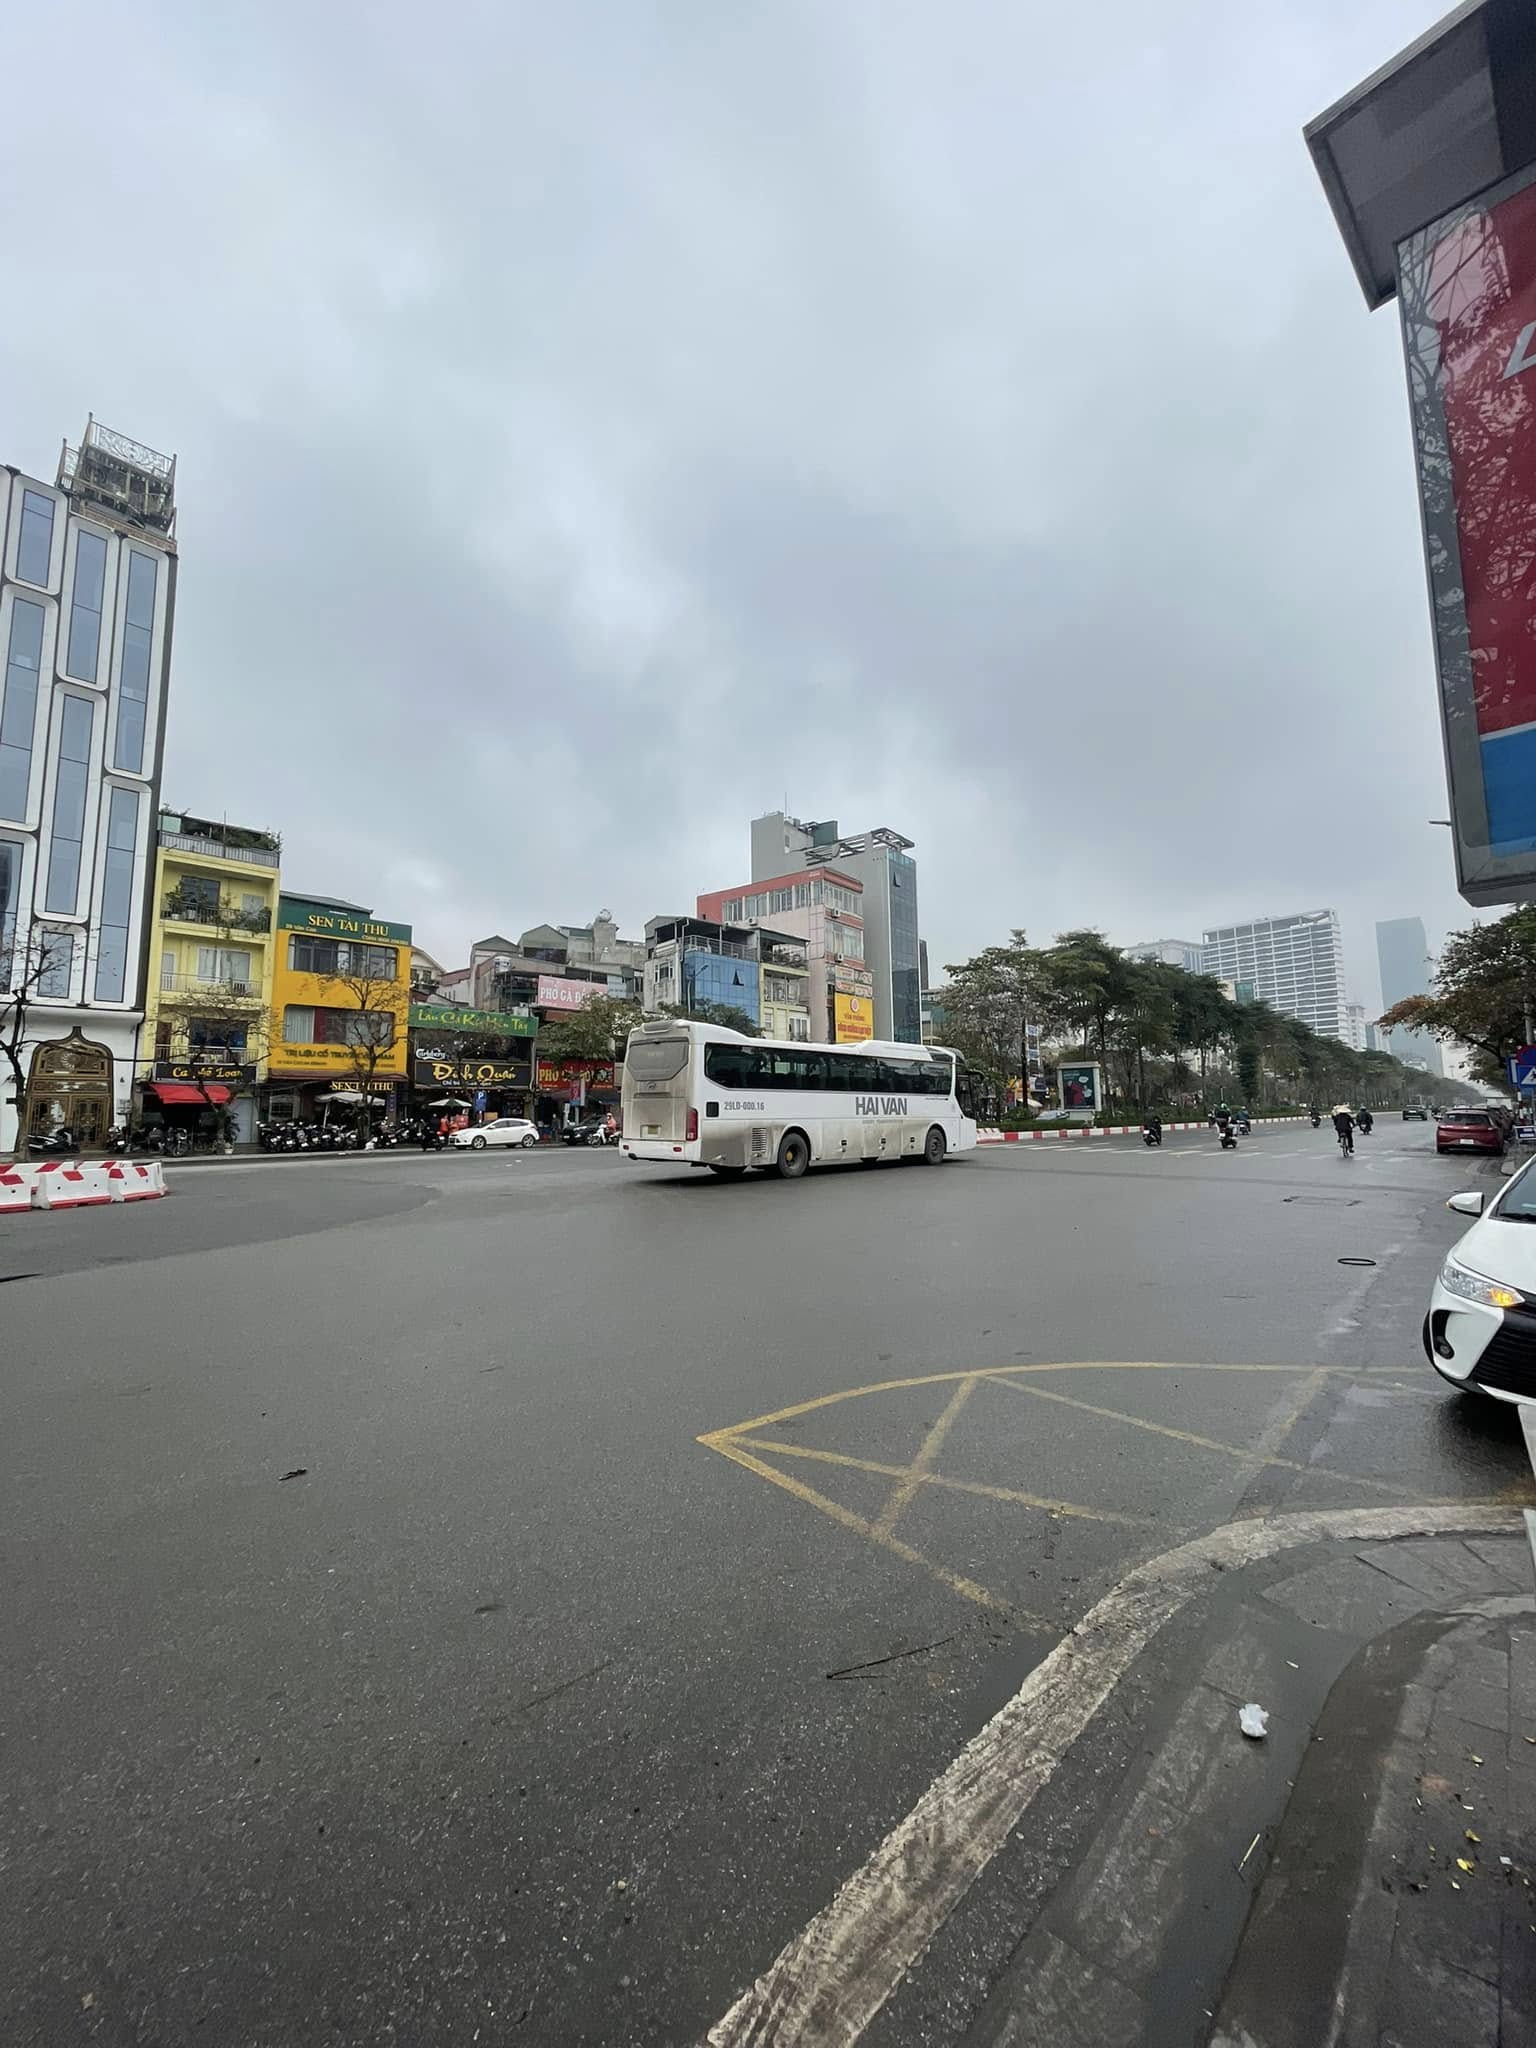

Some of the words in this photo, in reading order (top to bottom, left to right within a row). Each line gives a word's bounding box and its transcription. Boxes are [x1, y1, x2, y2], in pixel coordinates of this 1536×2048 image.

[308, 914, 334, 929] SEN
[337, 917, 359, 932] TÀI
[361, 921, 390, 937] THU
[416, 1048, 446, 1060] Carlsberg
[477, 1091, 485, 1100] P
[855, 1096, 879, 1116] HAI
[880, 1096, 908, 1116] VAN
